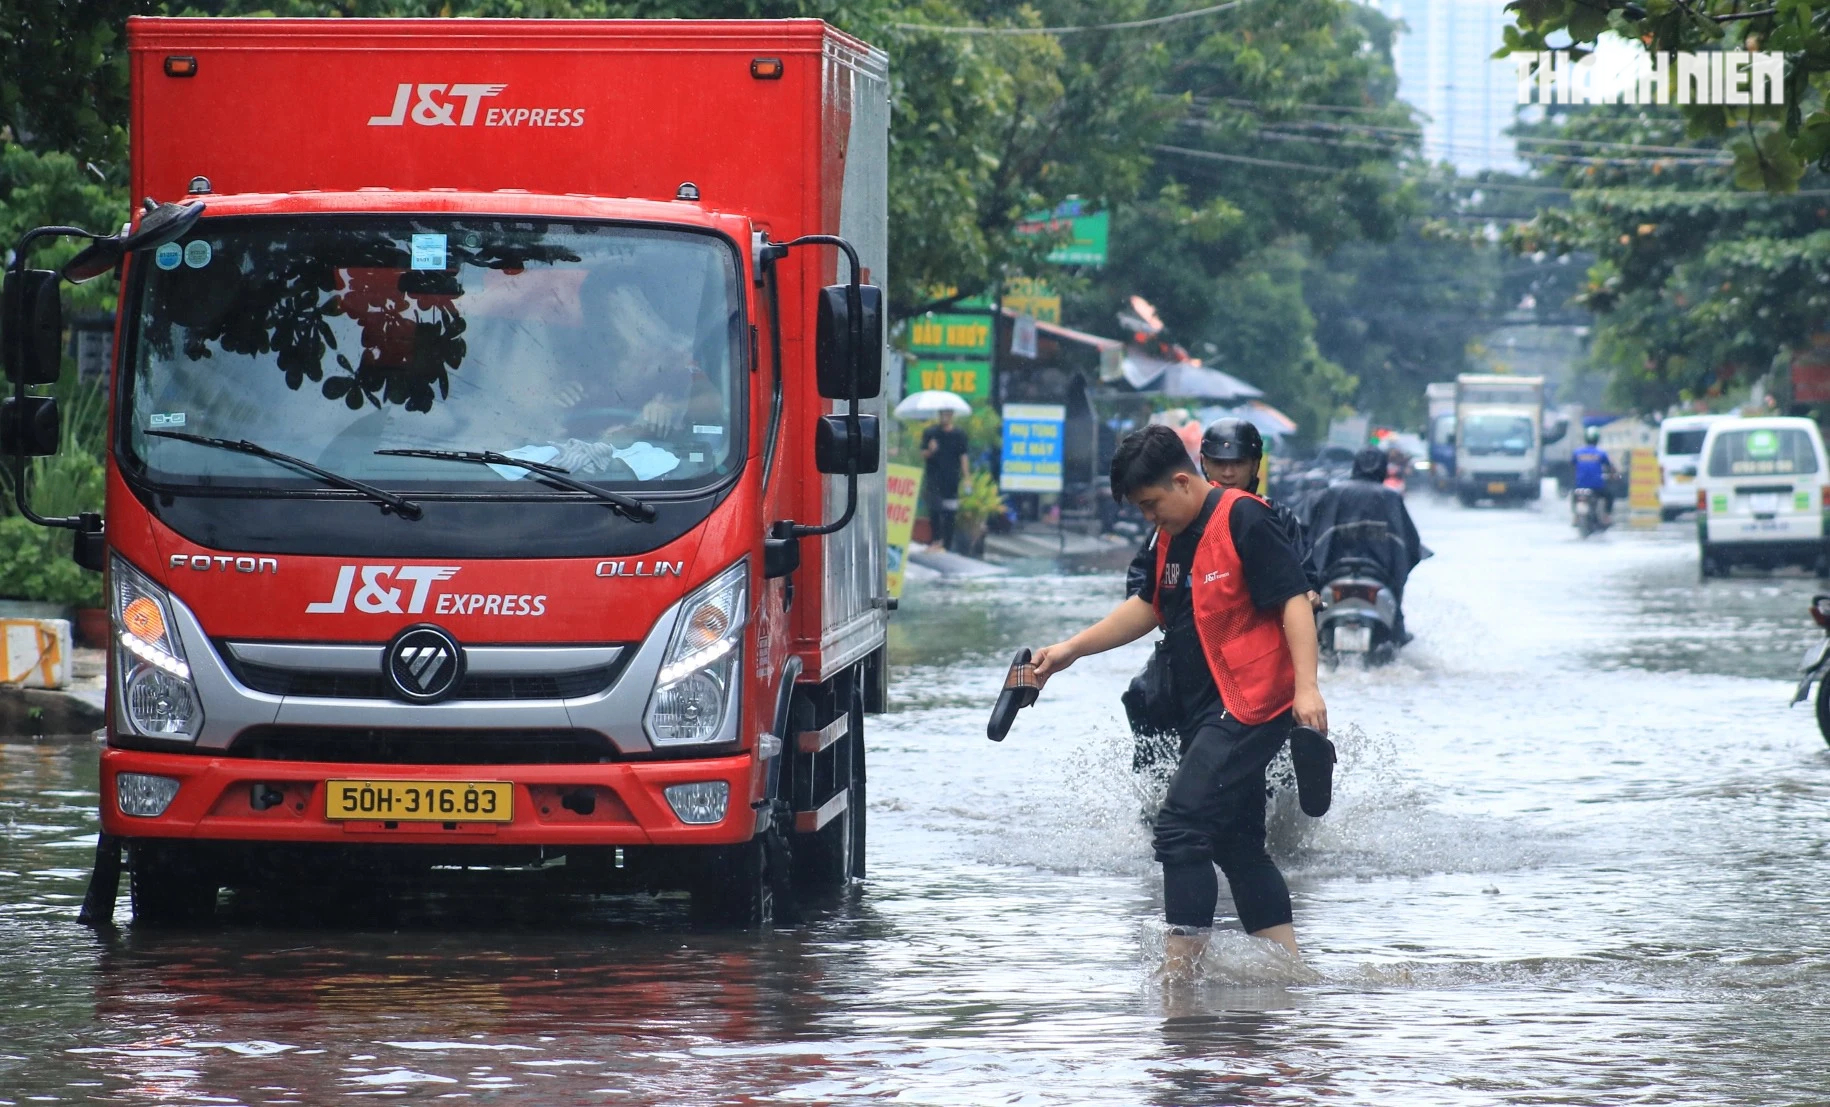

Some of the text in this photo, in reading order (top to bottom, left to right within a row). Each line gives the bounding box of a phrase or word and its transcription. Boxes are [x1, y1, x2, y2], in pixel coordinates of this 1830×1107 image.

[367, 83, 585, 127] J&T EXPRESS
[951, 370, 976, 392] XE
[169, 554, 278, 574] FOTON
[595, 560, 685, 577] OLLIN
[305, 566, 547, 616] J&T EXPRESS
[342, 787, 497, 814] 50H-316.83
